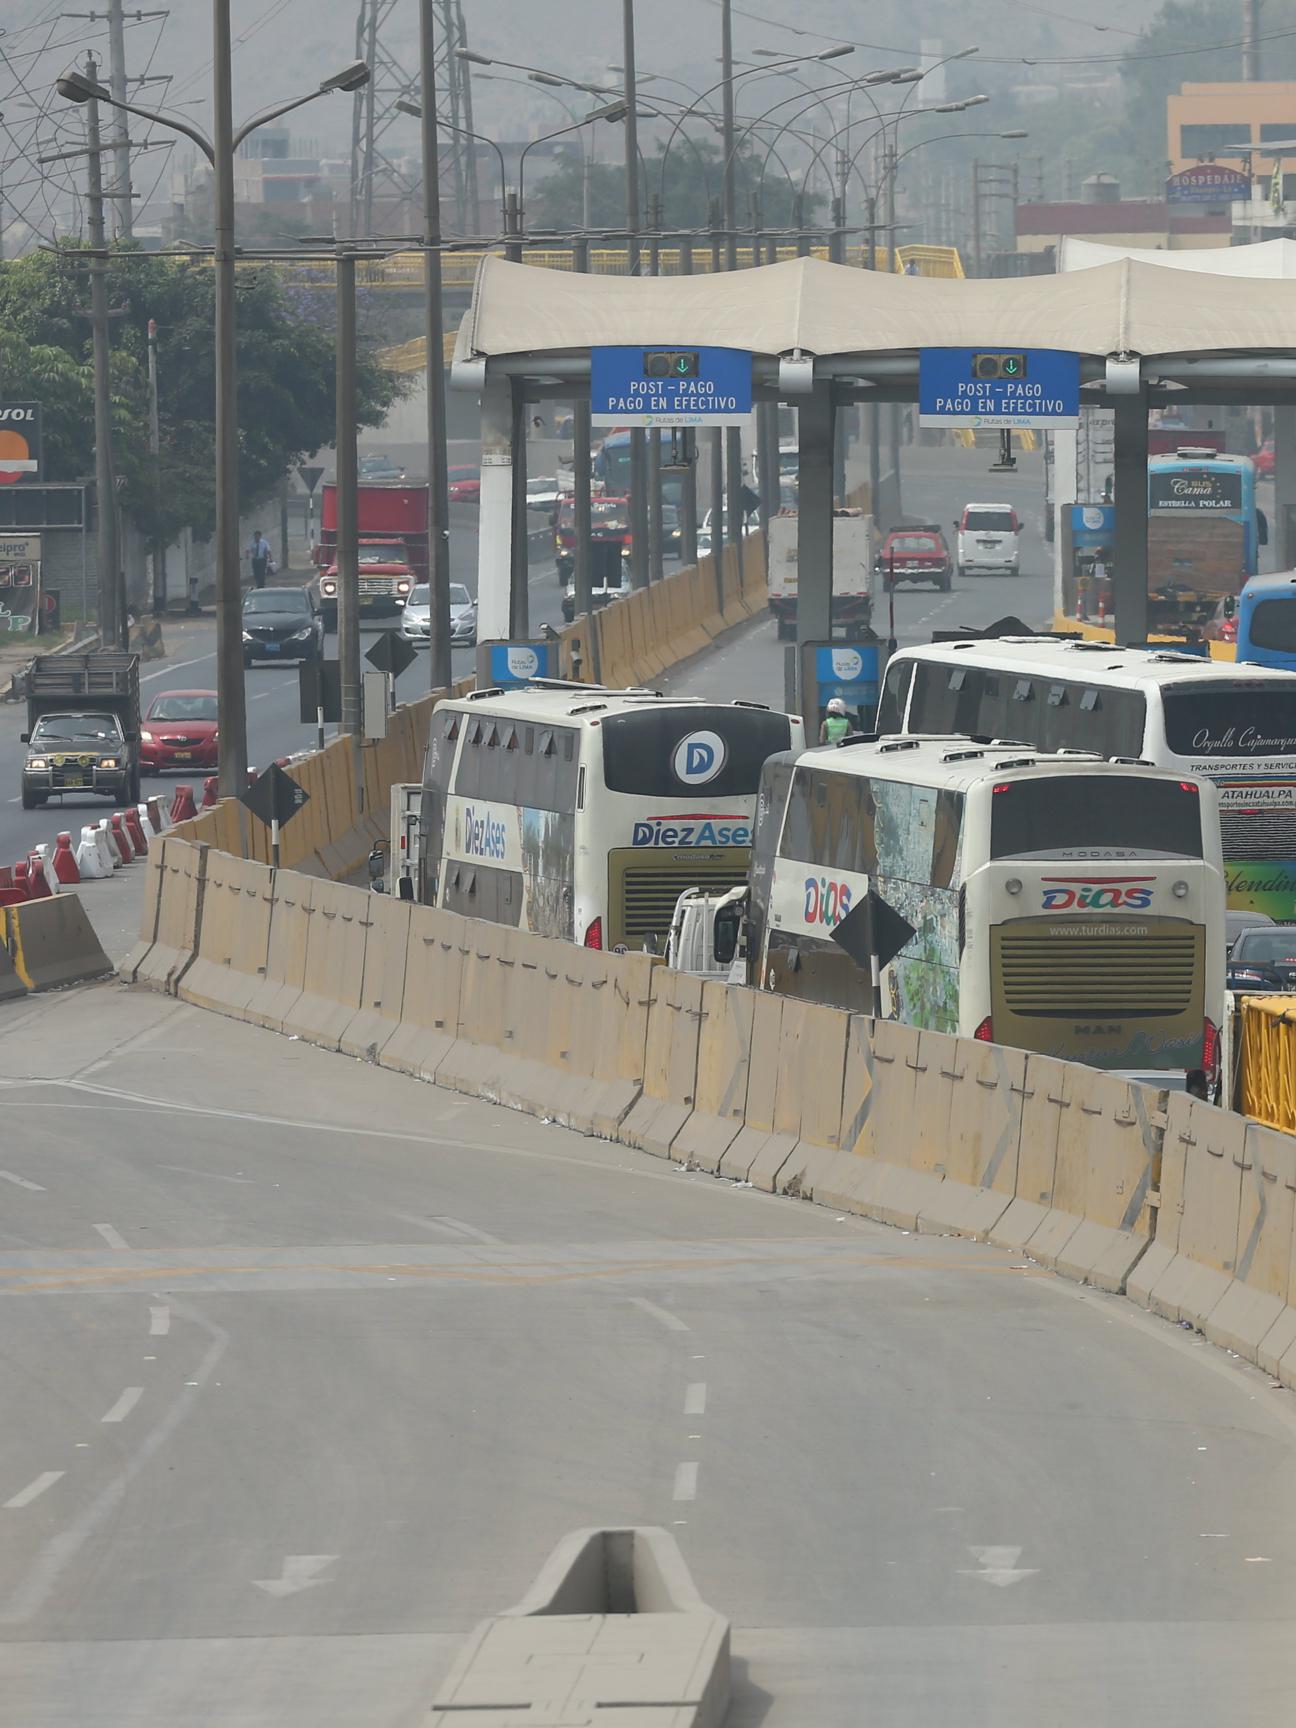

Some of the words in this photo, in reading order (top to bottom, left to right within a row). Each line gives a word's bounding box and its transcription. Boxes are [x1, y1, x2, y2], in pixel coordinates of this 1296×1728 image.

[1172, 175, 1243, 186] HOSPEDAJE
[630, 381, 664, 394] POST
[679, 381, 714, 394] PAGO
[958, 383, 991, 396] POST
[1007, 384, 1042, 396] PAGO
[609, 398, 643, 410] PAGO
[651, 398, 667, 409] EN
[674, 397, 736, 410] EFECTIVO
[936, 399, 971, 411] PAGO
[979, 399, 994, 411] EN
[1002, 399, 1063, 412] EFECTIVO
[1170, 479, 1212, 495] Cama
[1193, 728, 1235, 753] Orgullo
[686, 742, 714, 775] D
[1190, 763, 1254, 771] TRANSPORTES
[1221, 790, 1292, 799] ATAHUALPA
[465, 805, 506, 859] DiezAses
[1050, 924, 1148, 936] www.turdias.com
[1074, 1025, 1121, 1034] MAN
